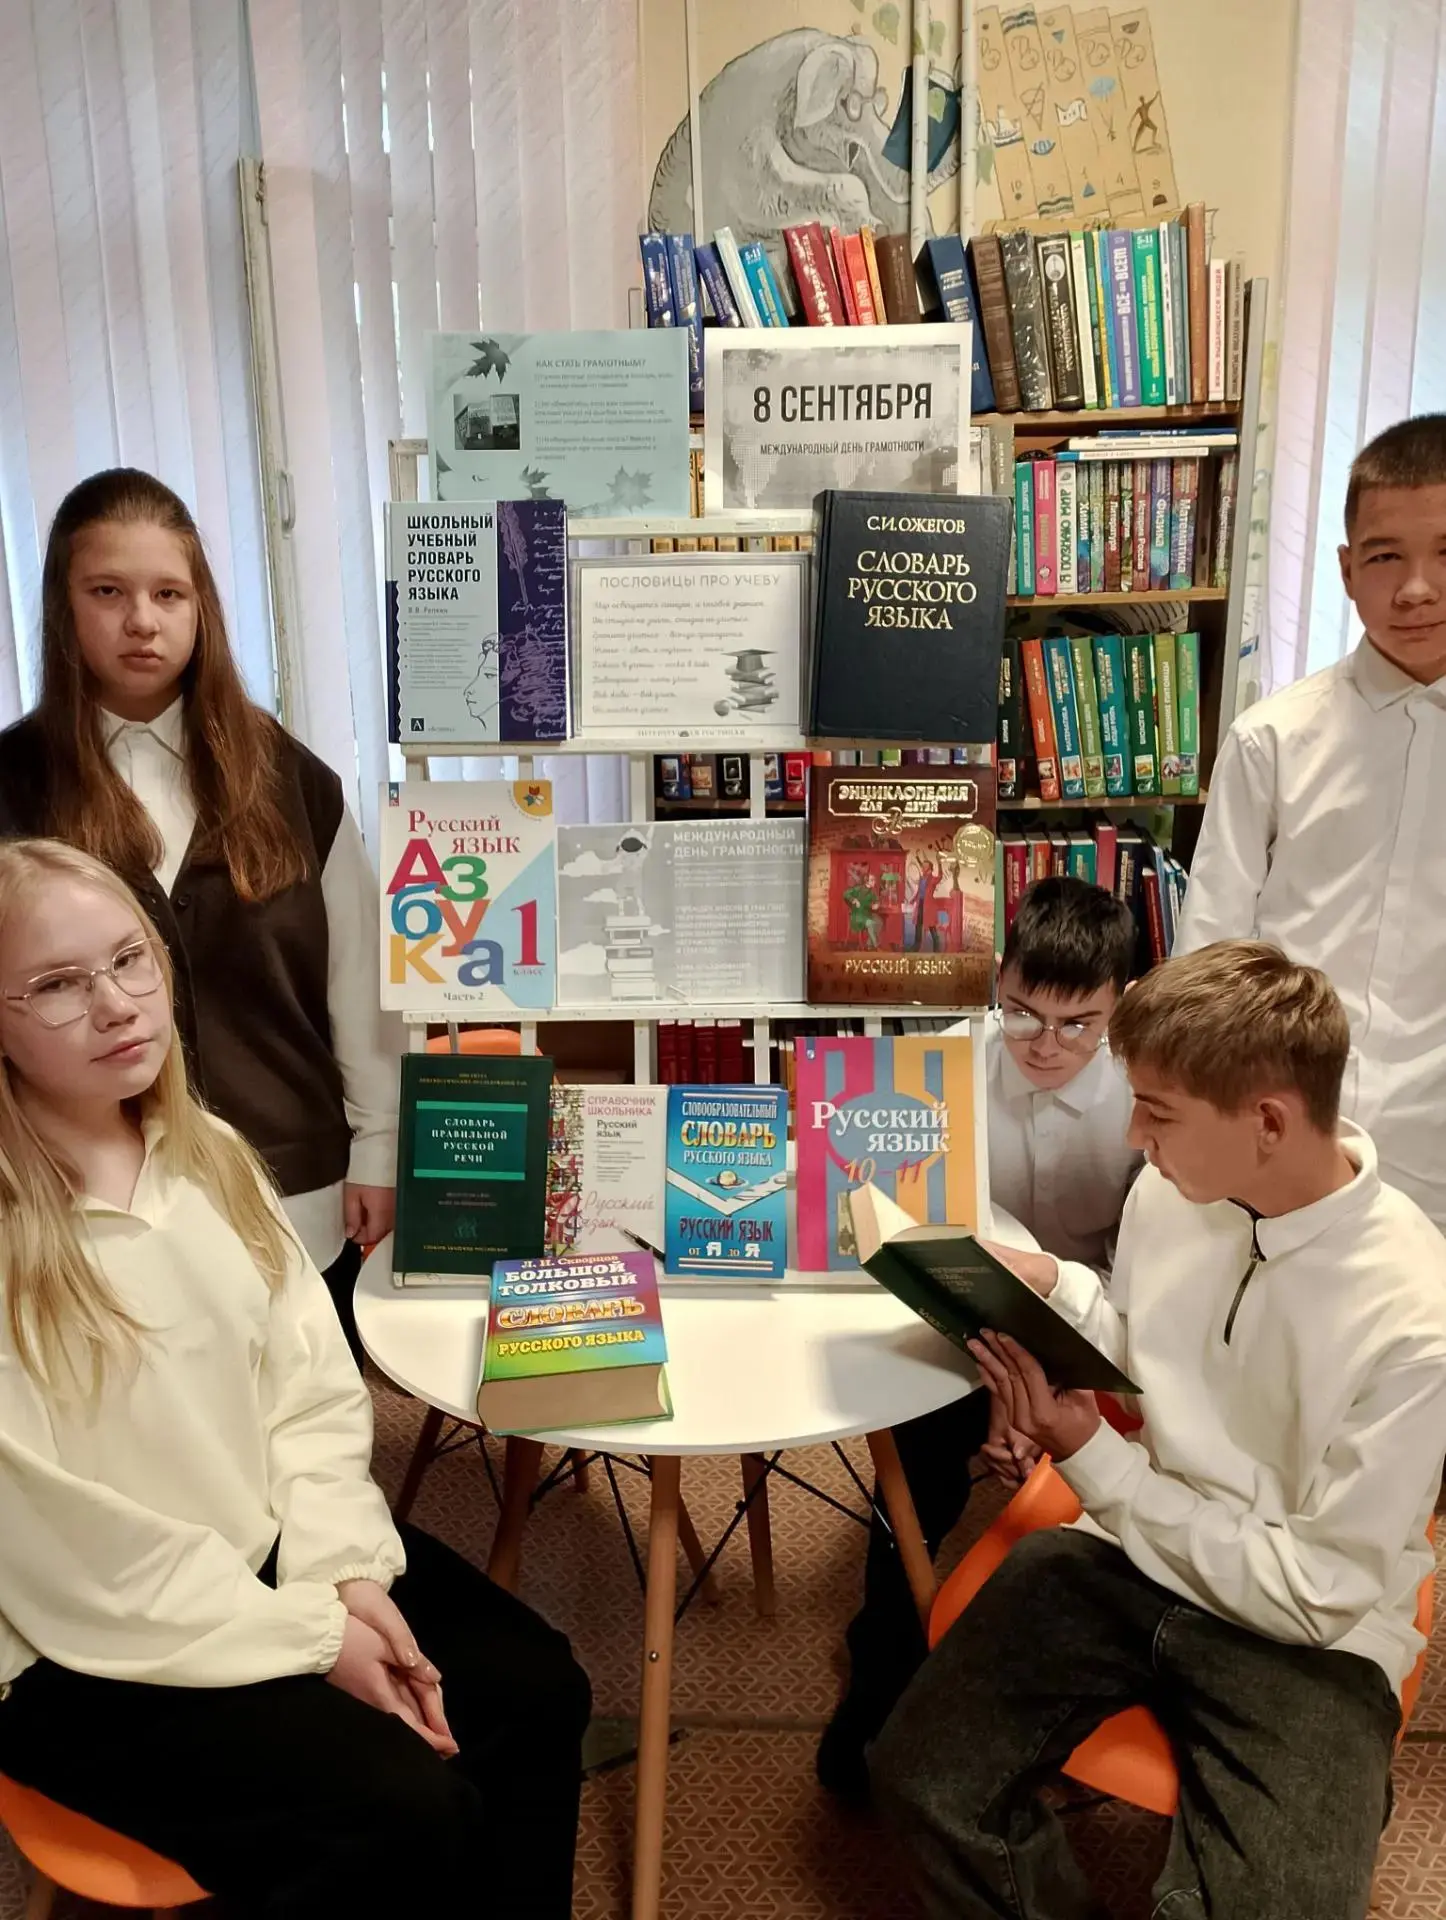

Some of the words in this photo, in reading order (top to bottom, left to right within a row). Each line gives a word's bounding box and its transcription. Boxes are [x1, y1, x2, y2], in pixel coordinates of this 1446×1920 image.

[753, 386, 771, 423] 8
[780, 382, 932, 422] СЕНТЯБРЯ
[760, 442, 839, 455] МЕЖДУНАРОДНЫЙ
[840, 442, 863, 454] ДЕНЬ
[865, 440, 925, 453] ГРАМОТНОСТИ
[407, 513, 493, 529] ШКОЛЬНЫЙ
[1079, 502, 1089, 541] Химия
[1108, 501, 1118, 551] Литература
[1155, 498, 1167, 548] Физика
[408, 531, 477, 547] УЧЕБНЫЙ
[1177, 498, 1191, 574] Математика
[408, 551, 474, 565] СЛОВАРЬ
[857, 550, 970, 577] СЛОВАРЬ
[408, 569, 481, 583] РУССКОГО
[599, 575, 696, 589] ПОСЛОВИЦЫ
[700, 575, 730, 587] ПРО
[734, 574, 781, 586] УЧЕБУ
[408, 587, 459, 601] ЯЗЫКА
[847, 577, 977, 604] РУССКОГО
[864, 605, 953, 630] ЯЗЫКА
[838, 785, 969, 802] ЭНЦИКЛОПЕДИЯ
[859, 801, 883, 812] ДЛЯ
[904, 800, 939, 812] ДЕТЕЙ
[408, 810, 501, 838] Русский
[673, 827, 796, 842] МЕЖДУНАРОДНЫЙ
[451, 836, 521, 854] язык
[674, 846, 709, 859] ДЕНЬ
[712, 844, 804, 857] ГРАМОТНОСТИ
[511, 899, 547, 966] 1
[845, 958, 910, 975] РУССКИЙ
[914, 960, 952, 975] ЯЗЫК
[443, 992, 476, 1001] Часть
[477, 992, 484, 1001] 2
[587, 1096, 656, 1106] СПРАВОЧНИК
[587, 1106, 653, 1116] ШКОЛЬНИКА
[682, 1101, 778, 1119] СЛОВООБРАЗОВАТЕЛЬНЫЙ
[810, 1100, 950, 1136] Русский
[444, 1118, 496, 1128] СЛОВАРЬ
[596, 1119, 638, 1130] Русский
[431, 1128, 508, 1141] ПРАВИЛЬНОЙ
[680, 1120, 777, 1150] СЛОВАРЬ
[867, 1133, 951, 1153] язык
[443, 1140, 495, 1152] РУССКОЙ
[454, 1154, 484, 1163] РЕЧИ
[683, 1150, 736, 1166] РУССКОГО
[737, 1153, 772, 1167] ЯЗЫКА
[584, 1190, 656, 1214] Русский
[680, 1216, 734, 1241] РУССКИЙ
[738, 1221, 773, 1242] ЯЗЫК
[705, 1241, 722, 1257] А
[744, 1243, 760, 1258] Я
[521, 1260, 536, 1269] Л.
[558, 1255, 619, 1266] Скворцов
[505, 1261, 627, 1283] БОЛЬШОЙ
[499, 1272, 638, 1296] ТОЛКОВЫЙ
[497, 1296, 646, 1329] СЛОВАРЬ
[498, 1335, 583, 1357] РУССКОГО
[584, 1329, 646, 1347] ЯЗЫКА
